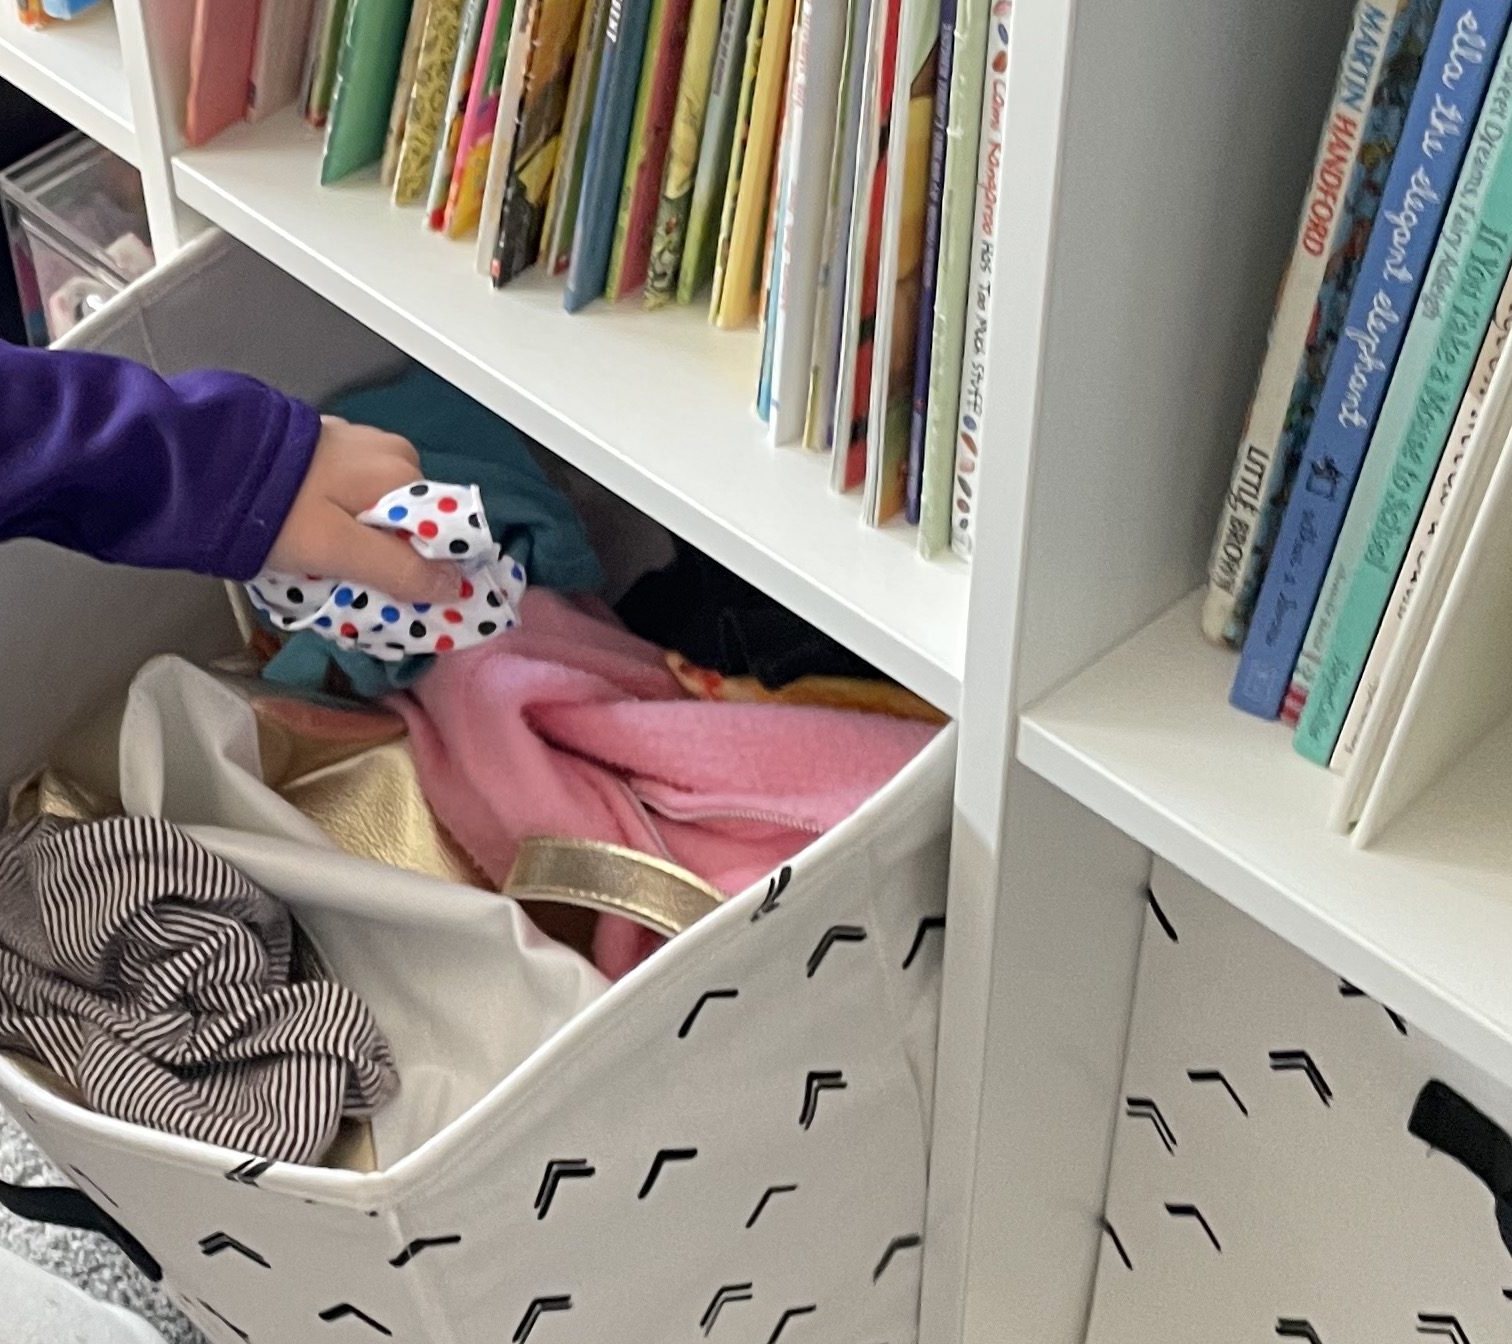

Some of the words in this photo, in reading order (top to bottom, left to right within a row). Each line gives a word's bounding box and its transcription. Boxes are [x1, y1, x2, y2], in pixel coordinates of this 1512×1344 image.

[1340, 3, 1386, 113] MARTIN
[1442, 10, 1486, 90] ella
[1422, 93, 1464, 159] the
[973, 138, 1003, 236] Kangaroo
[1303, 112, 1358, 256] HANDFORD
[978, 239, 994, 273] Has
[1383, 164, 1439, 284] elegant
[1473, 220, 1510, 253] If
[976, 279, 992, 311] Too
[1456, 248, 1501, 303] You
[972, 315, 988, 354] Much
[1338, 294, 1399, 429] elephant
[1434, 299, 1482, 368] Take
[965, 361, 986, 417] Stuff
